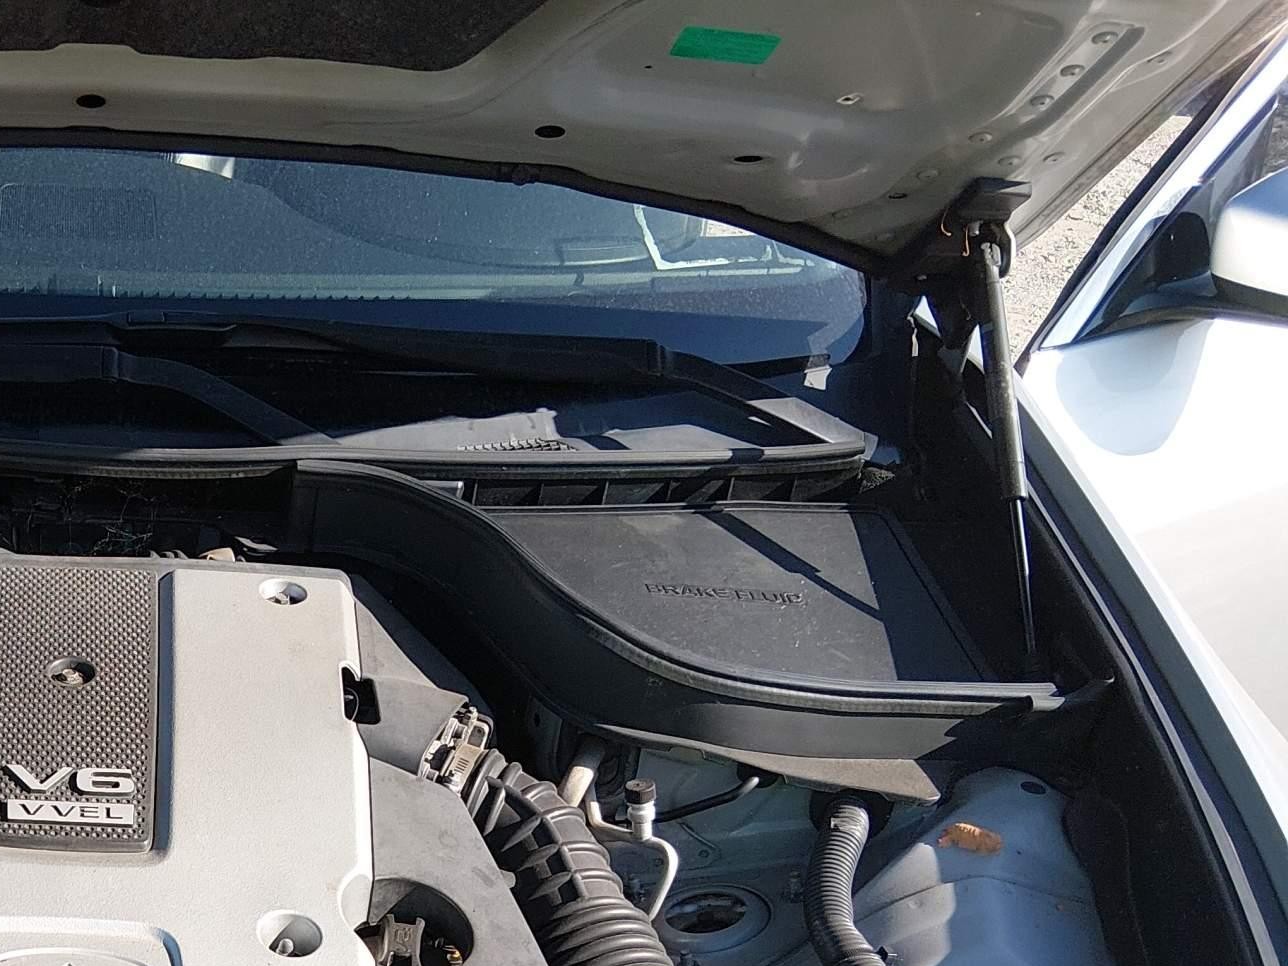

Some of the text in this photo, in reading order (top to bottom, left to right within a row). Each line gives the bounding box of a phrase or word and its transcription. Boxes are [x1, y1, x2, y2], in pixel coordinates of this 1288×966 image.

[644, 583, 802, 605] BRAKE FLUID
[3, 763, 136, 795] V6
[19, 803, 123, 820] VVEL
